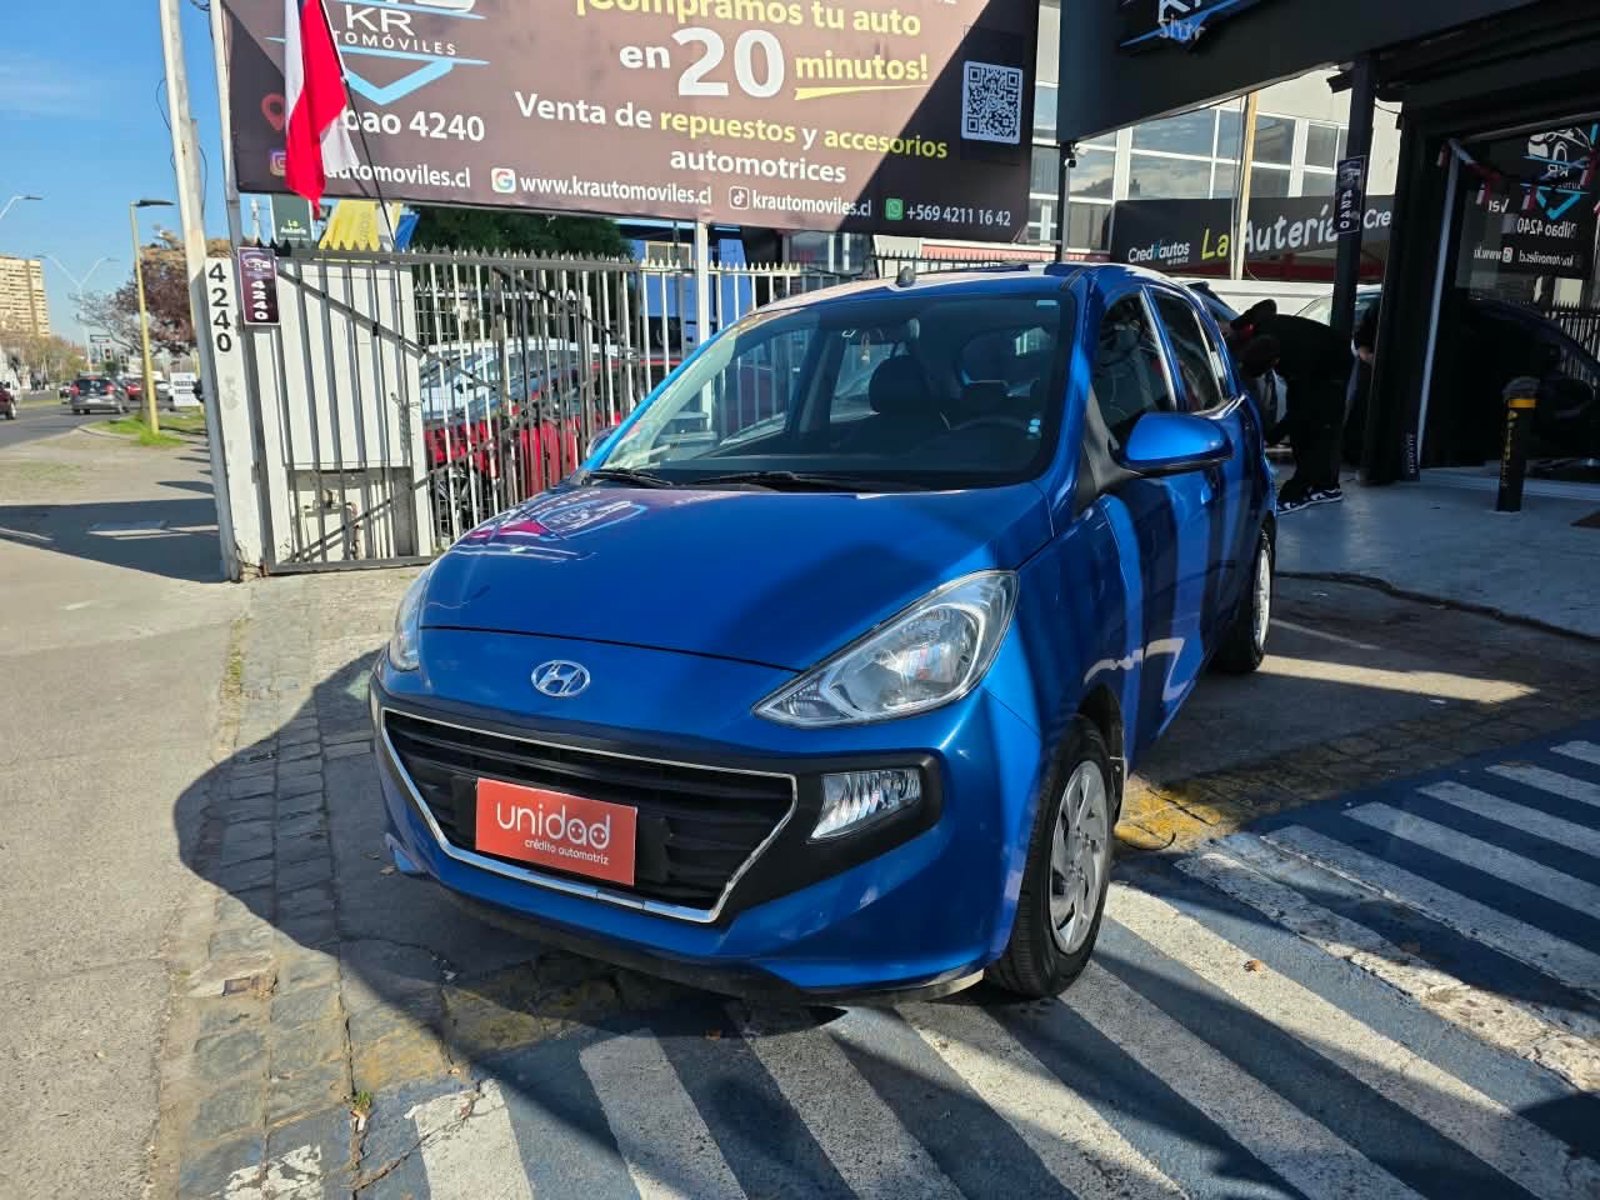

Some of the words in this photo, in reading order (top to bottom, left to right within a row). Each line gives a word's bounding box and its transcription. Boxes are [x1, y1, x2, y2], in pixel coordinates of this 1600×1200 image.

[345, 4, 415, 36] KR
[811, 2, 845, 29] tu
[853, 9, 921, 36] auto
[333, 29, 456, 56] TOMÓVILES
[619, 45, 671, 69] en
[671, 27, 785, 98] 20
[795, 50, 928, 80] minutos!
[344, 107, 402, 135] bao
[409, 111, 485, 142] 4240
[515, 91, 606, 125] Venta
[615, 102, 652, 128] de
[660, 111, 797, 143] repuestos
[802, 127, 817, 150] y
[824, 130, 948, 159] accesorios
[670, 150, 847, 182] automotrices
[519, 175, 712, 205] www.krautomoviles.cl
[752, 189, 872, 217] krautomoviles.cl
[906, 205, 941, 222] +569
[943, 206, 974, 225] 4211
[979, 209, 993, 225] 16
[996, 210, 1011, 227] 42
[1202, 227, 1230, 260] La
[1363, 209, 1391, 229] Cre
[208, 262, 232, 353] 4240
[250, 279, 270, 321] 4240
[496, 802, 611, 849] unidad
[558, 846, 609, 865] automotriz
